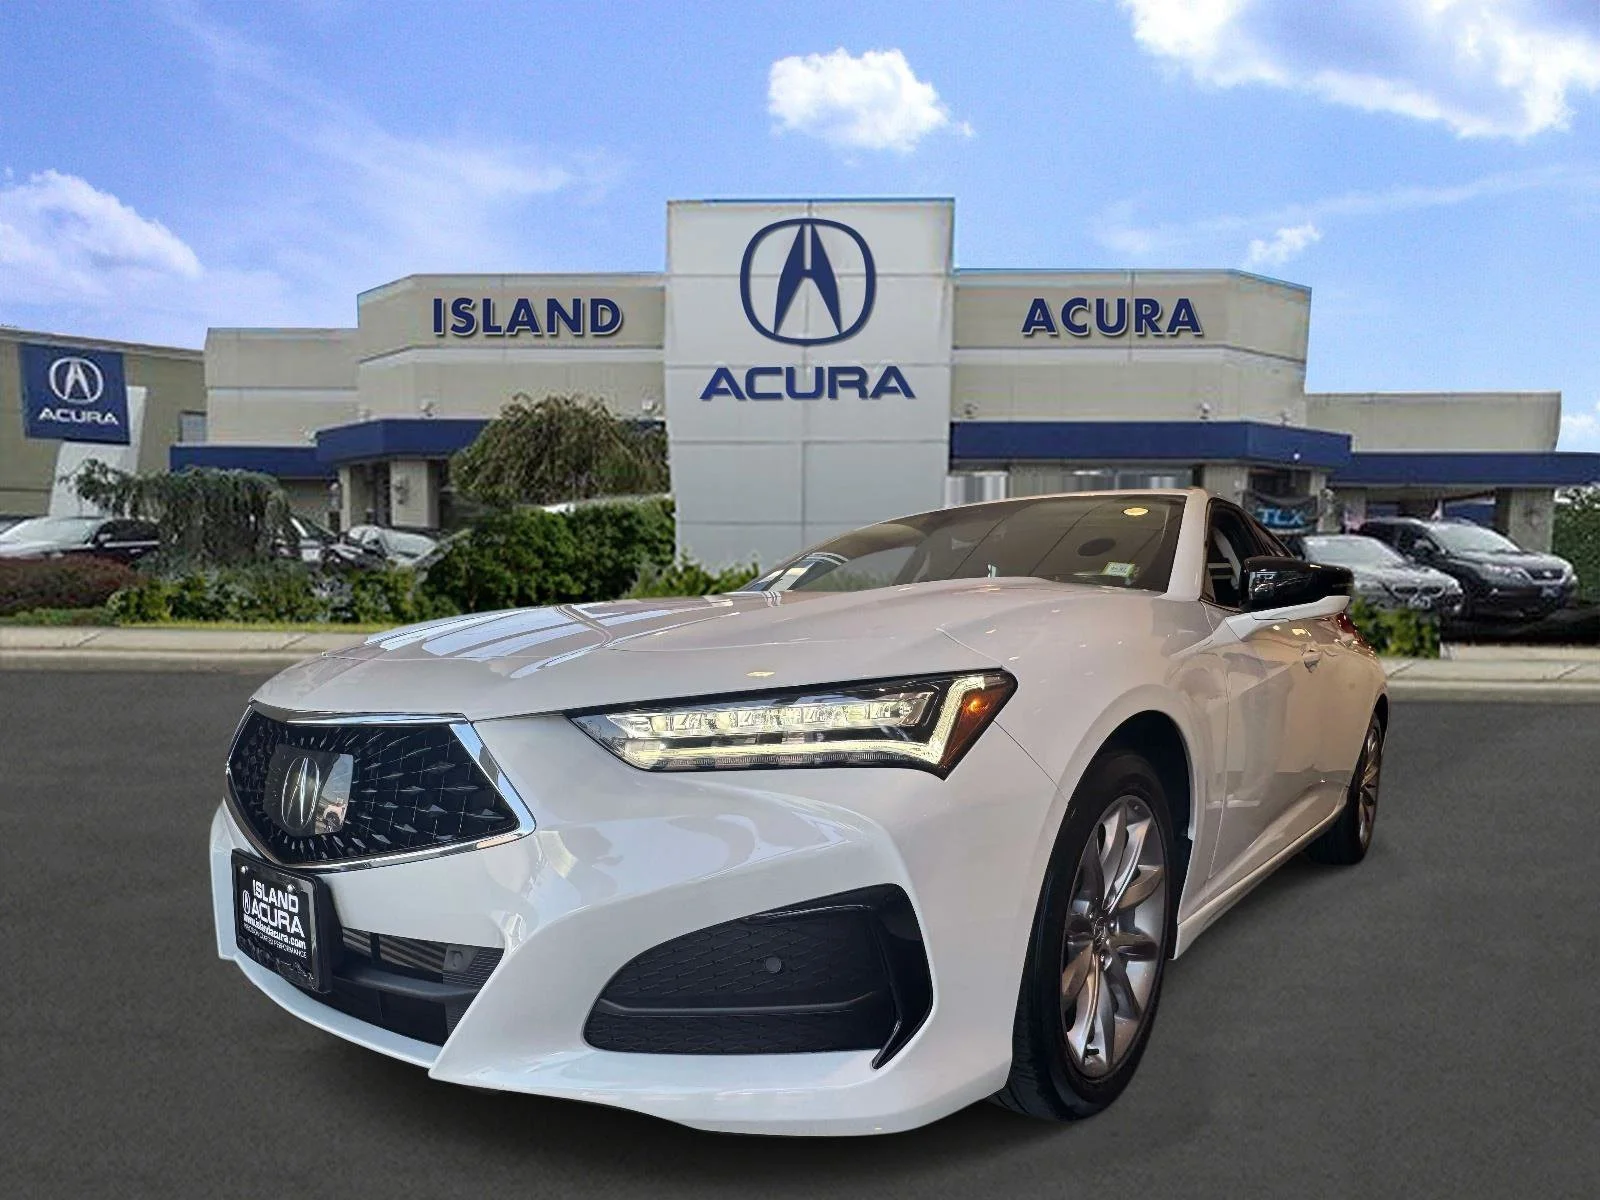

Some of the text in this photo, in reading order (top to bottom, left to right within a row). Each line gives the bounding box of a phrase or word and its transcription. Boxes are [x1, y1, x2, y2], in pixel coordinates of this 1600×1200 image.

[433, 297, 622, 335] ISLAND
[1021, 297, 1204, 336] ACURA
[699, 365, 916, 401] ACURA
[38, 408, 119, 425] ACURA
[1257, 508, 1305, 525] TLX
[252, 879, 299, 914] ISLAND
[251, 898, 306, 938] ACURA
